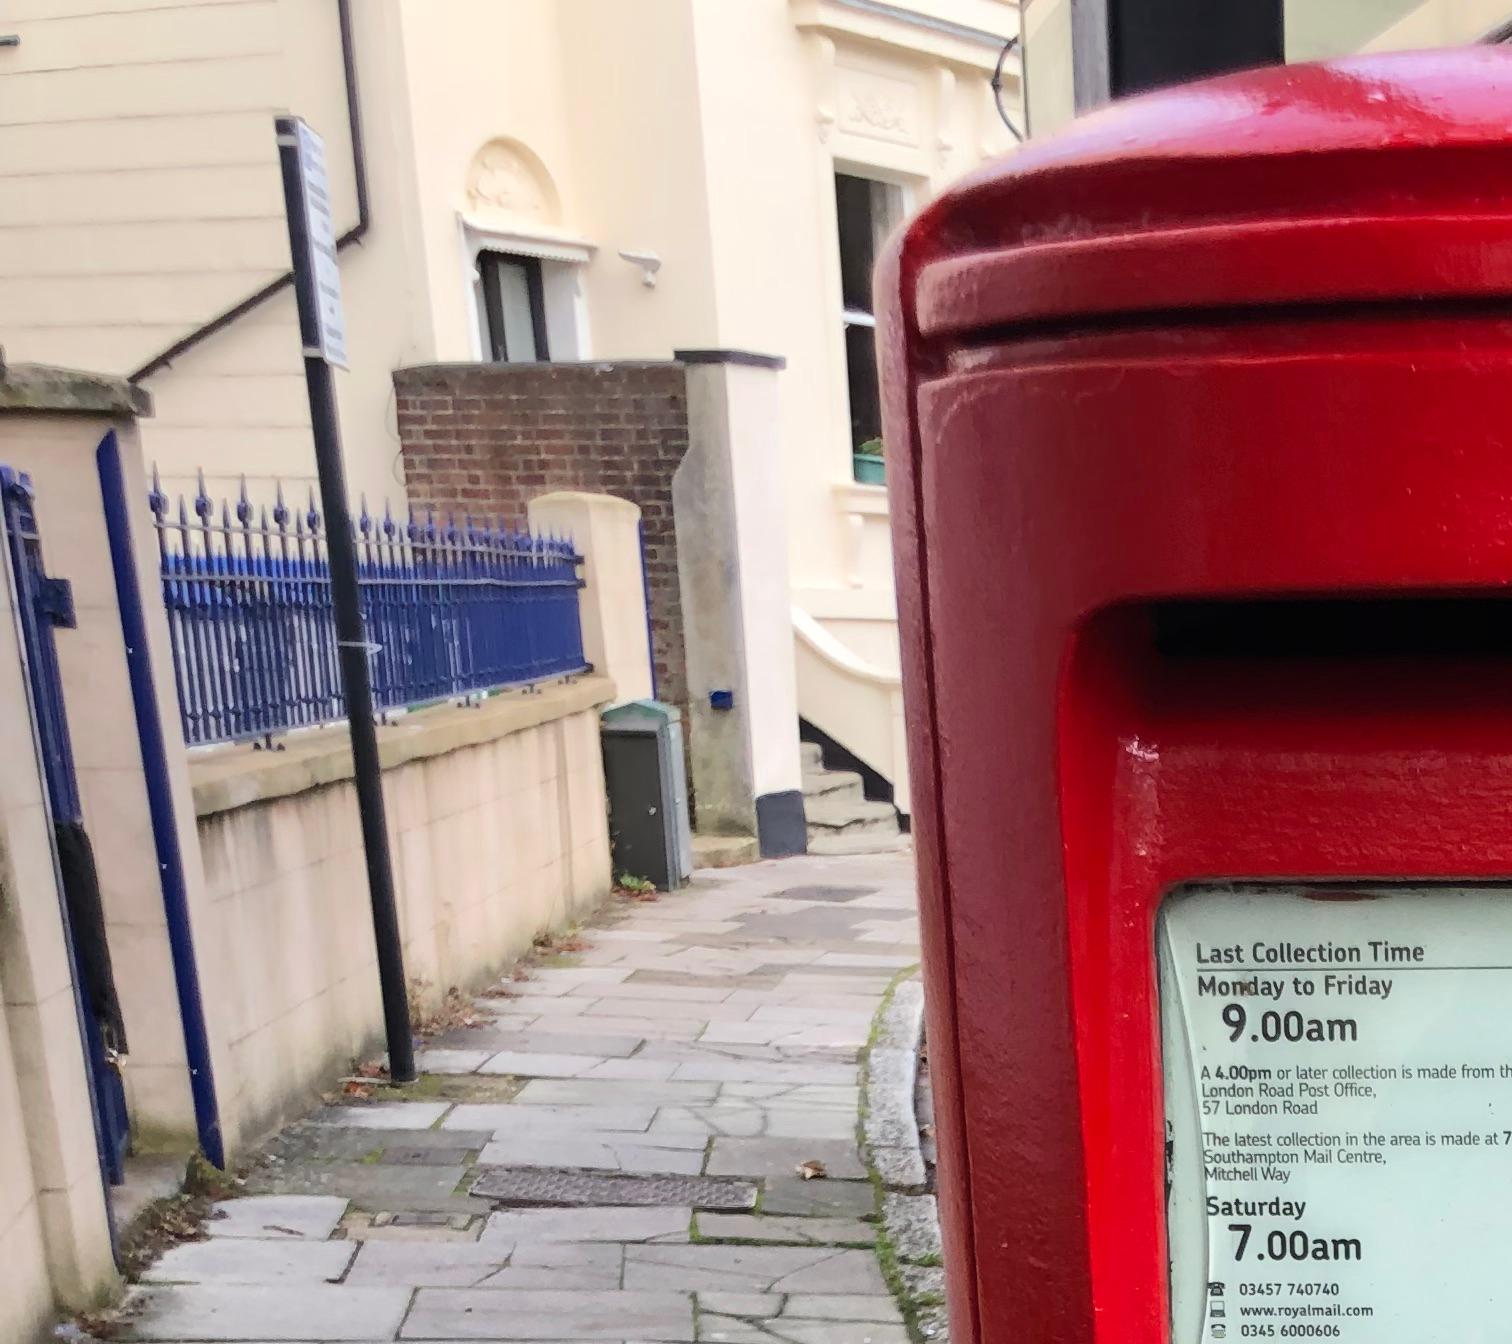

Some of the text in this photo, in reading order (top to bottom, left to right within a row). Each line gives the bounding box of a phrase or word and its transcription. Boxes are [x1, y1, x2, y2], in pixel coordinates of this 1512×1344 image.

[1196, 941, 1424, 964] Last Collection Time
[1198, 975, 1393, 1000] Monday to Friday
[1222, 1003, 1357, 1042] 9.00am
[1201, 1066, 1211, 1080] A
[1215, 1065, 1272, 1082] 4.00pm
[1277, 1068, 1289, 1079] or
[1296, 1065, 1328, 1079] later
[1332, 1065, 1397, 1079] collection
[1401, 1065, 1413, 1079] is
[1417, 1064, 1457, 1079] made
[1461, 1064, 1495, 1079] from
[1202, 1082, 1377, 1099] London Road Post Office,
[1202, 1100, 1318, 1115] 57 London Road
[1203, 1132, 1230, 1147] The
[1235, 1132, 1273, 1146] latest
[1277, 1132, 1341, 1146] collection
[1345, 1132, 1359, 1146] in
[1363, 1132, 1386, 1146] the
[1390, 1134, 1421, 1146] area
[1425, 1131, 1437, 1146] is
[1441, 1131, 1481, 1146] made
[1485, 1132, 1500, 1145] at
[1204, 1149, 1387, 1167] Southampton Mail Centre,
[1205, 1167, 1291, 1184] Mitchell Way
[1206, 1196, 1306, 1221] Saturday
[1228, 1224, 1362, 1262] 7.00am
[1239, 1283, 1340, 1296] 03457 740740
[1240, 1304, 1373, 1319] www.royalmail.com
[1241, 1324, 1341, 1337] 0345 6000606
